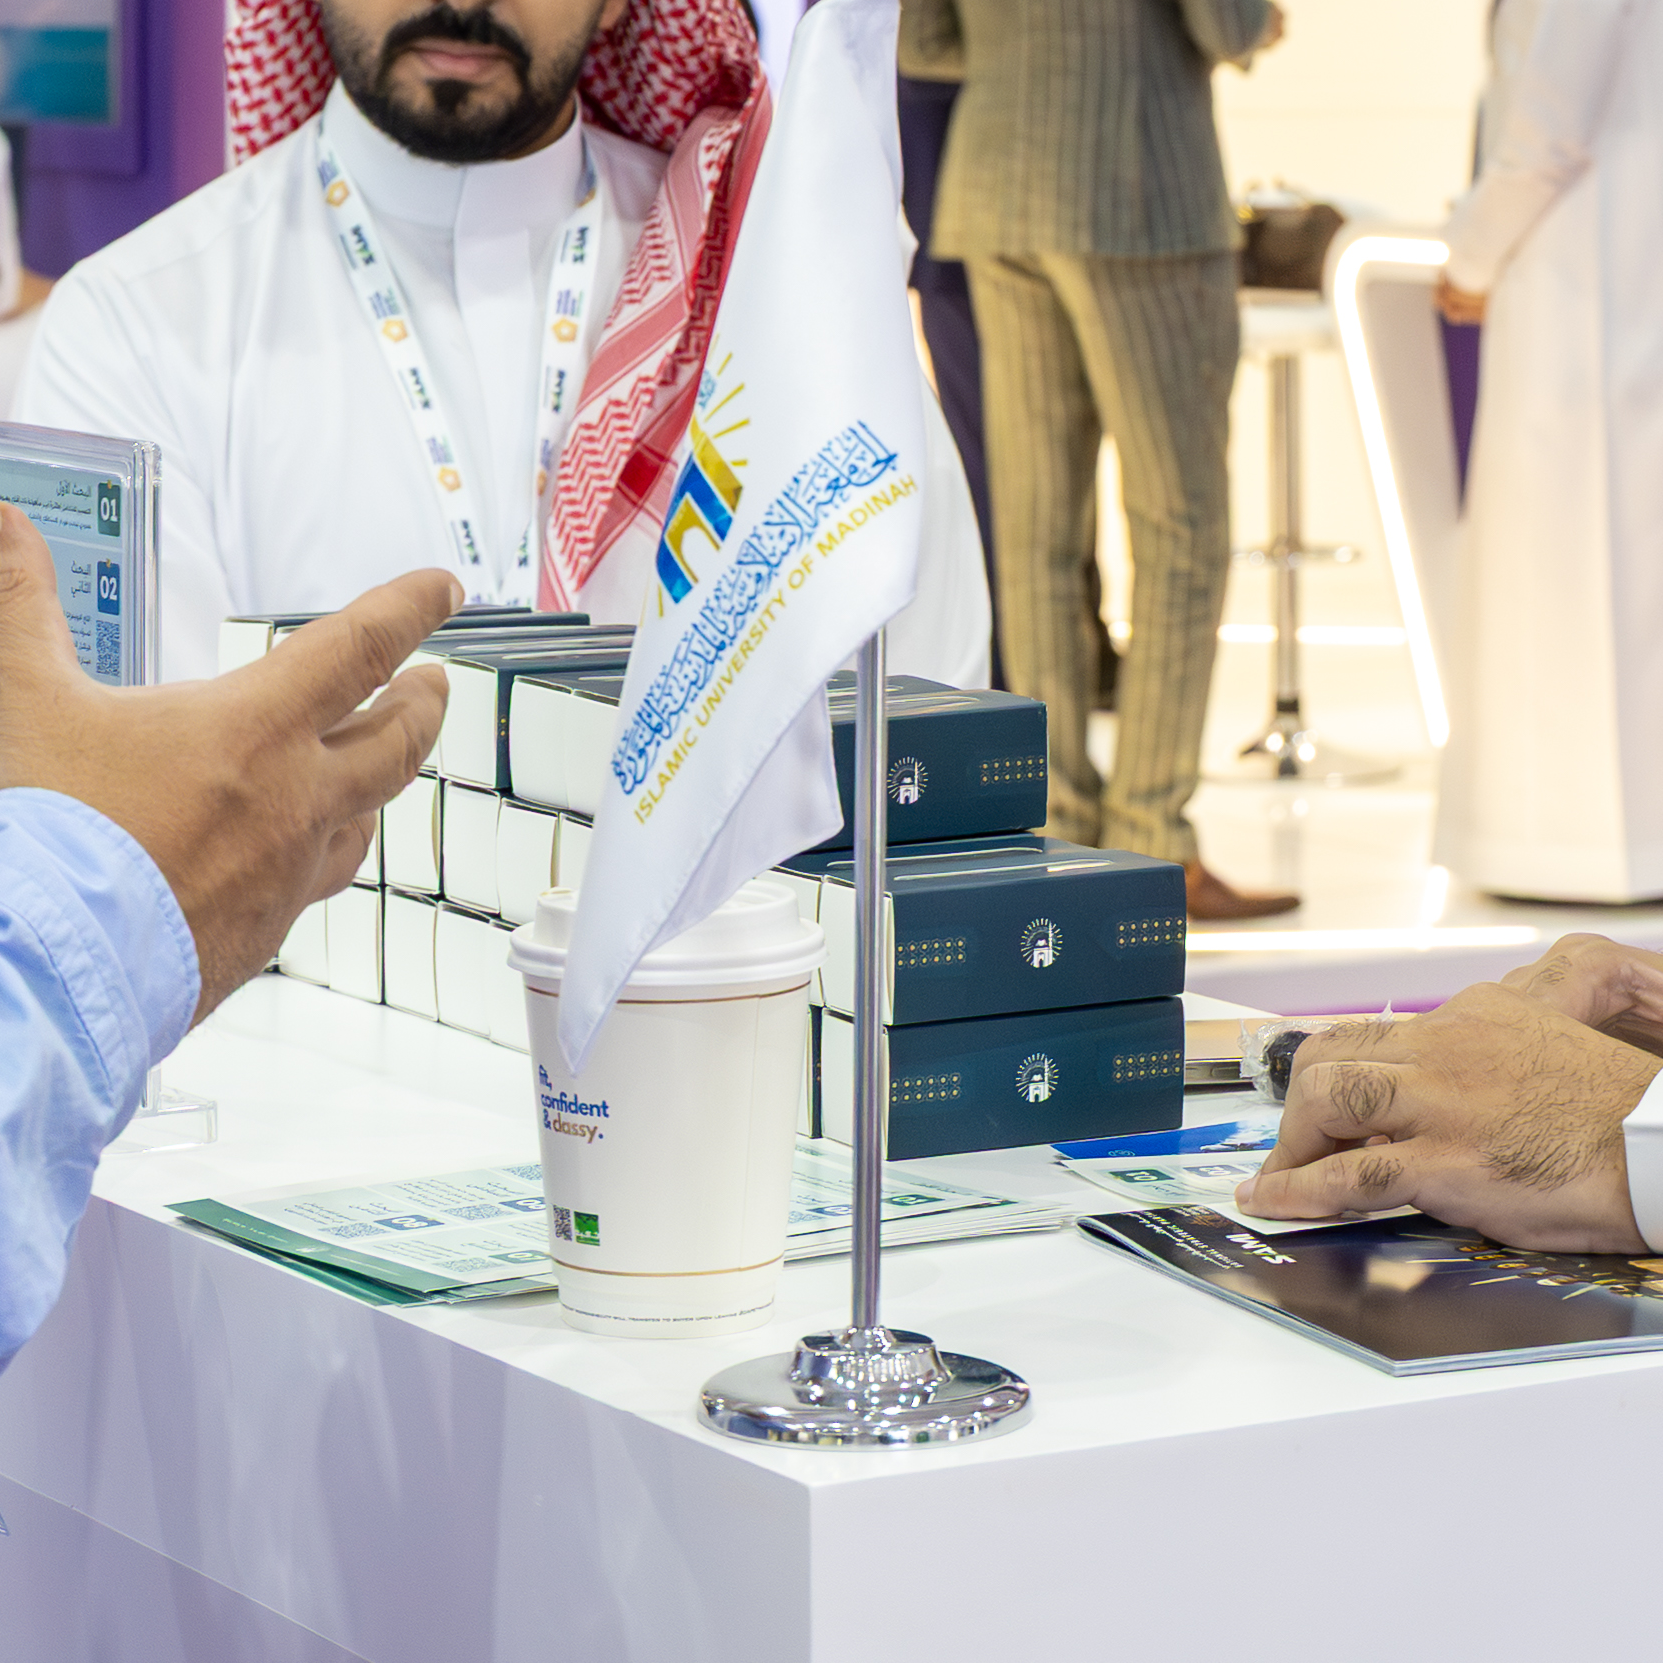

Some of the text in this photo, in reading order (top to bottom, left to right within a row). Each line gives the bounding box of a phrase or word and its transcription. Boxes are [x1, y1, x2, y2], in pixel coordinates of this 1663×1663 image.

[100, 497, 118, 522] 01
[99, 575, 118, 601] 02
[632, 473, 917, 825] ISLAMIC UNIVERSITY OF MADINAH
[541, 1091, 610, 1119] confident
[543, 1108, 552, 1130] &
[1225, 1232, 1298, 1265] SAMI
